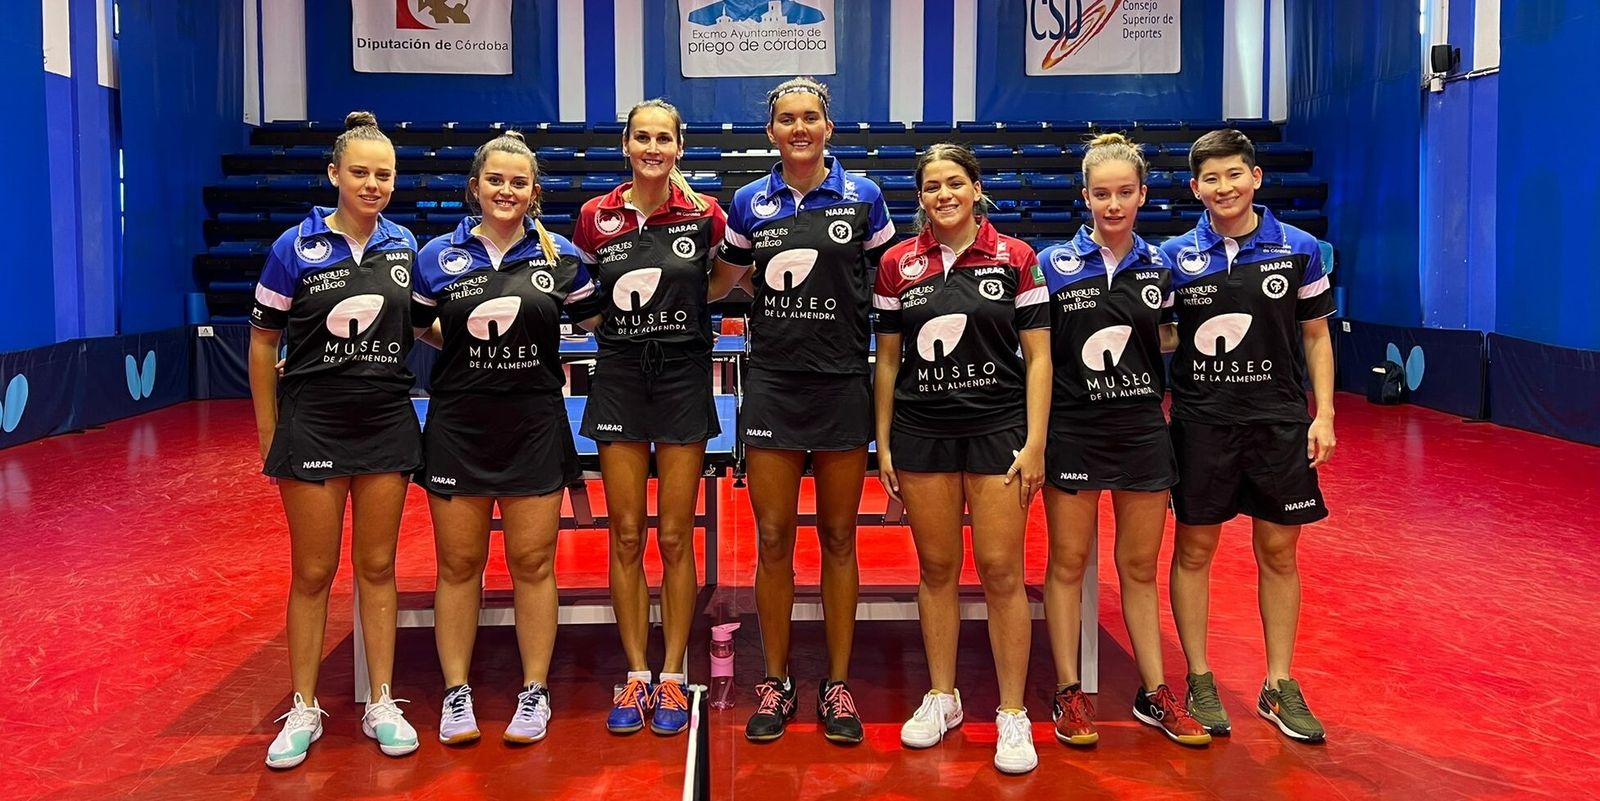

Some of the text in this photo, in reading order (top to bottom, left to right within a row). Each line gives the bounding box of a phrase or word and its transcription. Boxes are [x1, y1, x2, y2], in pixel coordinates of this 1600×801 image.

[1123, 0, 1158, 12] Consejo
[1031, 0, 1083, 40] CSD
[1123, 14, 1173, 28] Superior de
[692, 28, 821, 39] Excmo Ayuntamiento de
[1123, 28, 1162, 40] Deportes
[356, 38, 508, 50] Diputación de Córdoba
[688, 38, 826, 55] priego de córdoba
[825, 208, 856, 217] NARAQ
[668, 224, 698, 234] NARAQ
[386, 252, 409, 262] NARAQ
[974, 267, 1005, 276] NARAQ
[1260, 261, 1293, 272] NARAQ
[1136, 272, 1160, 280] NARAQ
[310, 280, 346, 294] PRIEGO
[764, 295, 836, 310] MUSEO
[1063, 300, 1097, 313] PRIEGO
[615, 310, 687, 326] MUSEO
[764, 309, 836, 320] DE LA ALMENDRA
[618, 327, 627, 335] DE
[630, 327, 638, 335] LA
[325, 340, 401, 355] MUSEO
[469, 344, 538, 359] MUSEO
[323, 354, 335, 363] DE
[469, 360, 540, 370] DE LA ALMENDRA
[1193, 359, 1272, 373] MUSEO
[918, 362, 996, 381] MUSEO
[1086, 372, 1151, 391] MUSEO
[1210, 374, 1221, 382] LA
[1225, 374, 1272, 383] ALMENDRA
[919, 377, 998, 392] DE LA ALMENDRA
[1090, 392, 1102, 401] DE
[596, 424, 623, 433] NARAQ
[746, 428, 772, 438] NARAQ
[303, 460, 333, 469] NARAQ
[1060, 472, 1089, 481] NARAQ
[1284, 499, 1316, 512] NARAQ
